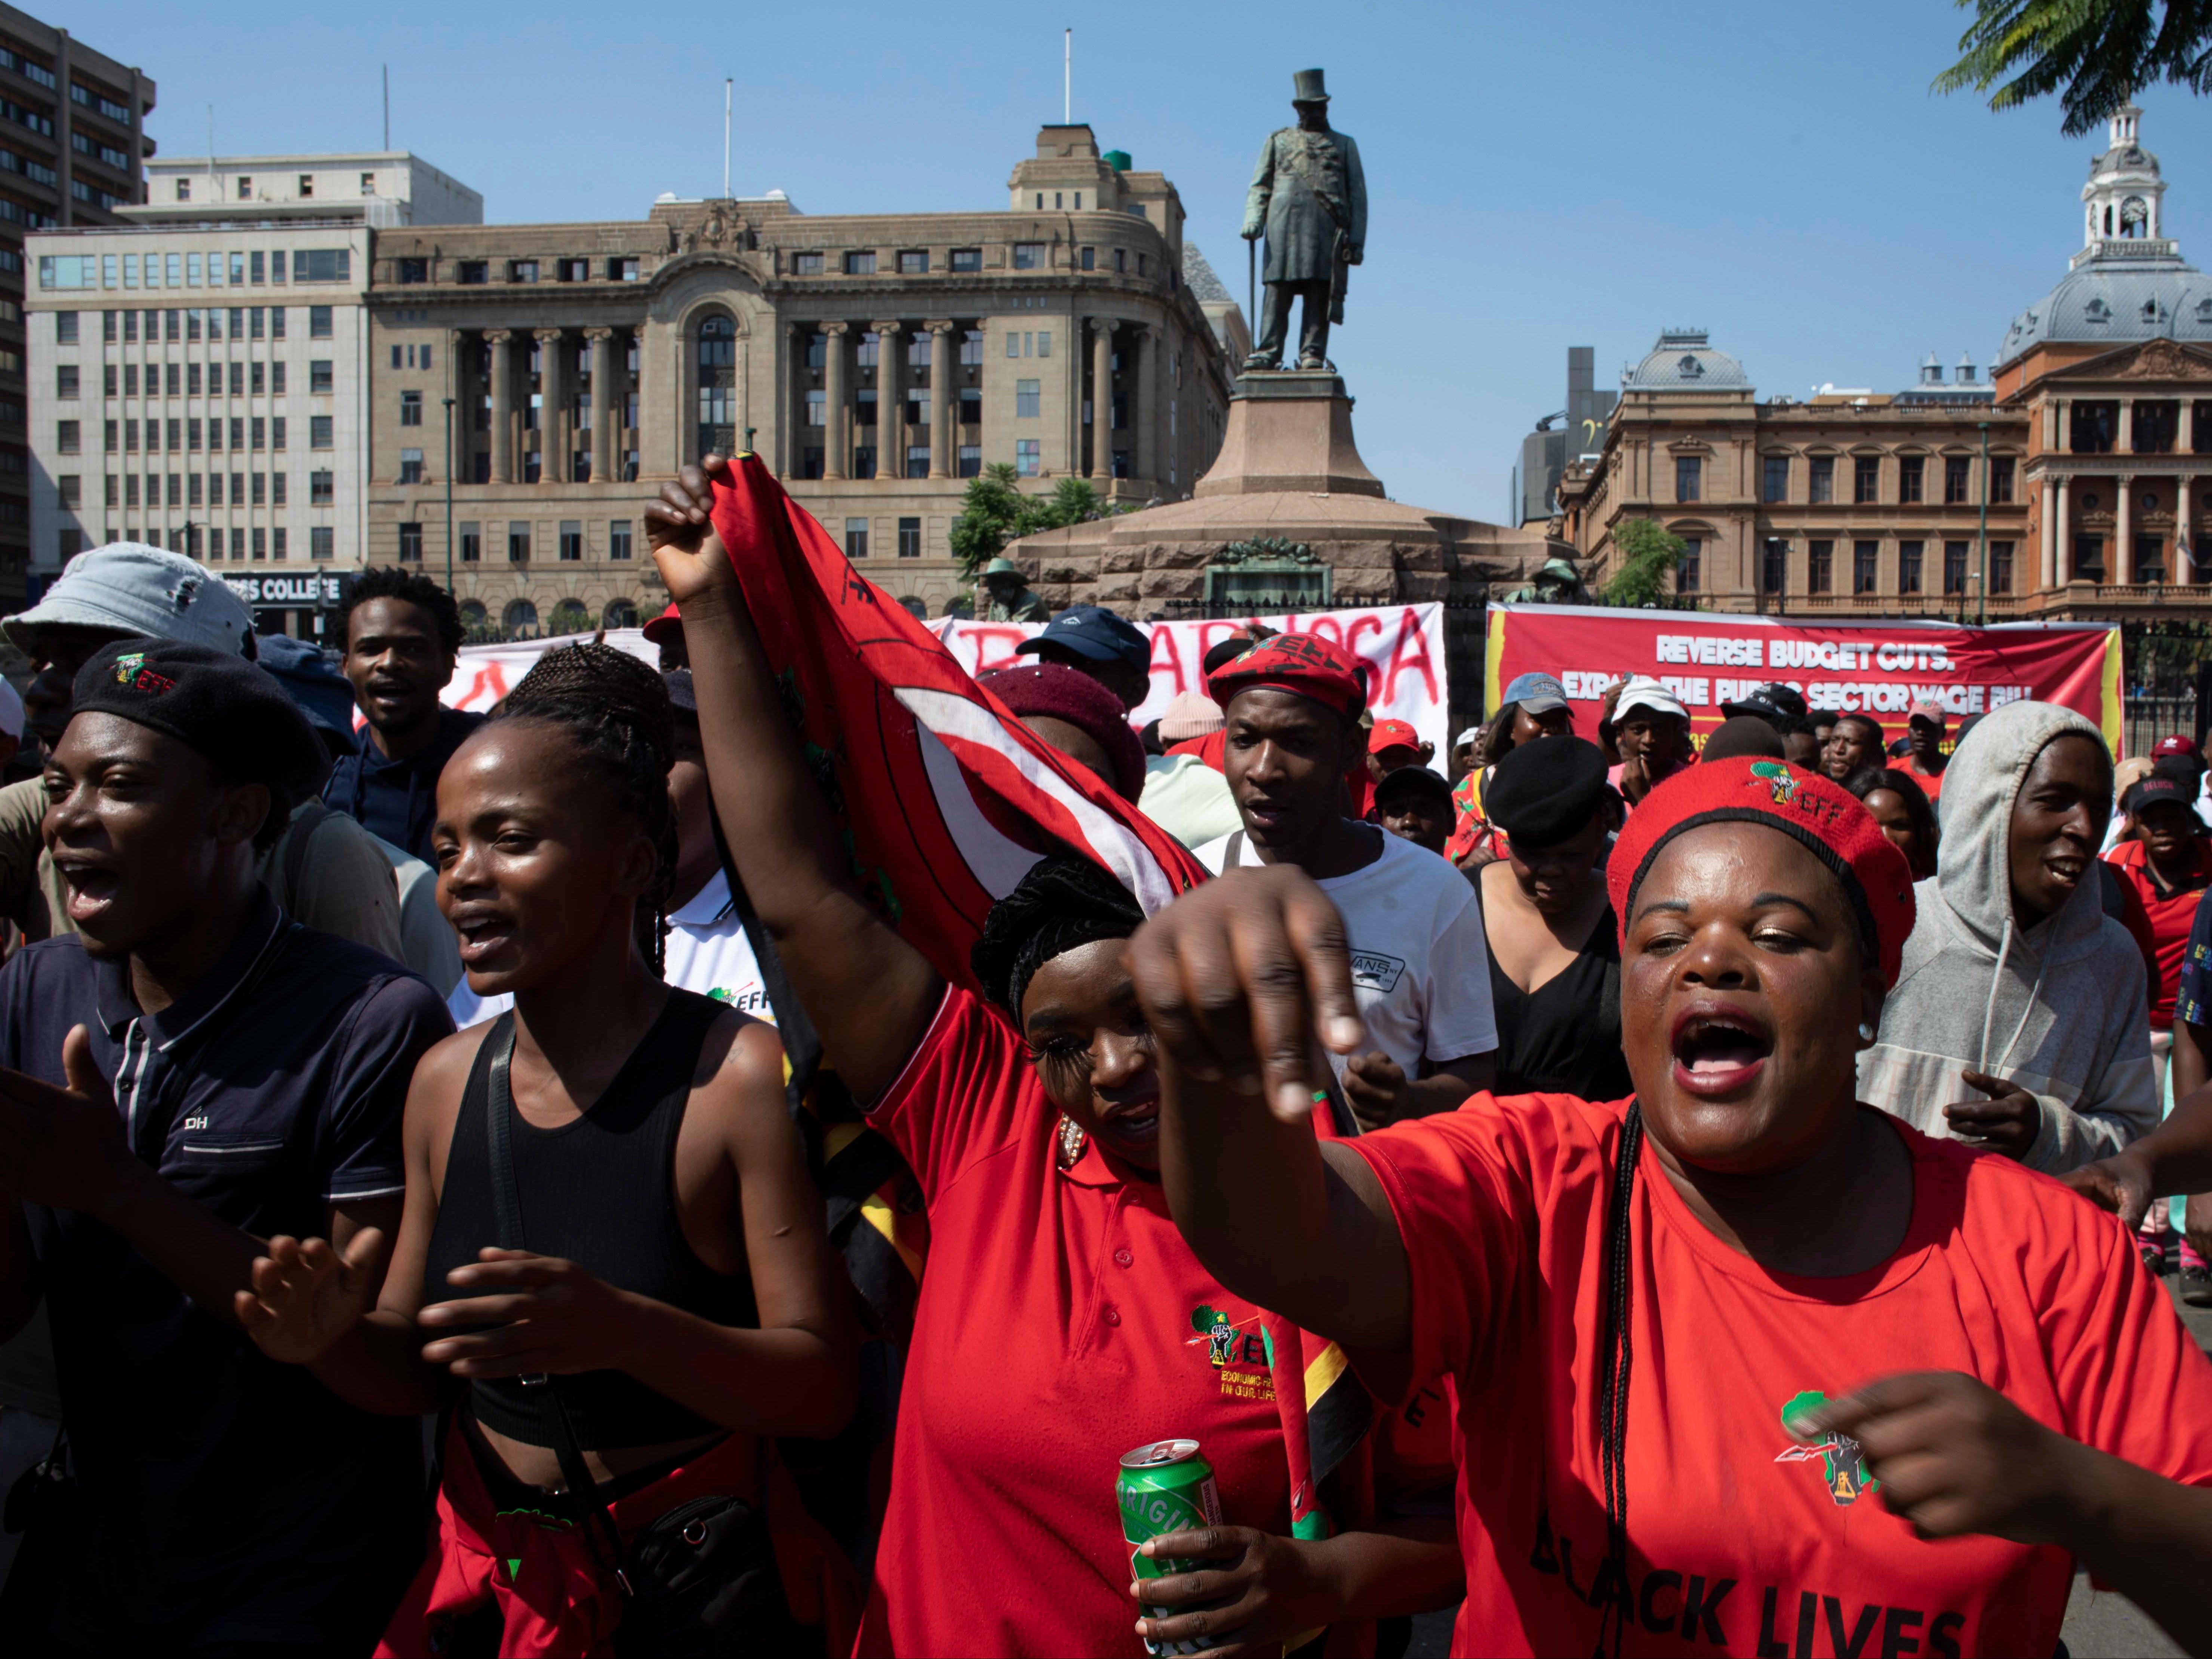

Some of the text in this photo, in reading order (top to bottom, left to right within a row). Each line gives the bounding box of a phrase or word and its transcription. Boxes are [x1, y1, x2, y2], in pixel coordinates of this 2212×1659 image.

[1656, 635, 1955, 672] REVERSE BUDGET CUTS.
[136, 670, 176, 696] EFF
[1807, 682, 1909, 712] SECTOR
[1800, 791, 1845, 825] EFF
[184, 1116, 208, 1129] DH
[1221, 1370, 1261, 1386] ECONOMIC
[1221, 1383, 1233, 1395] IN
[1235, 1385, 1256, 1398] OUR
[1203, 1483, 1216, 1526] DANGEROUS
[1530, 1506, 1966, 1659] BLACK LIVES
